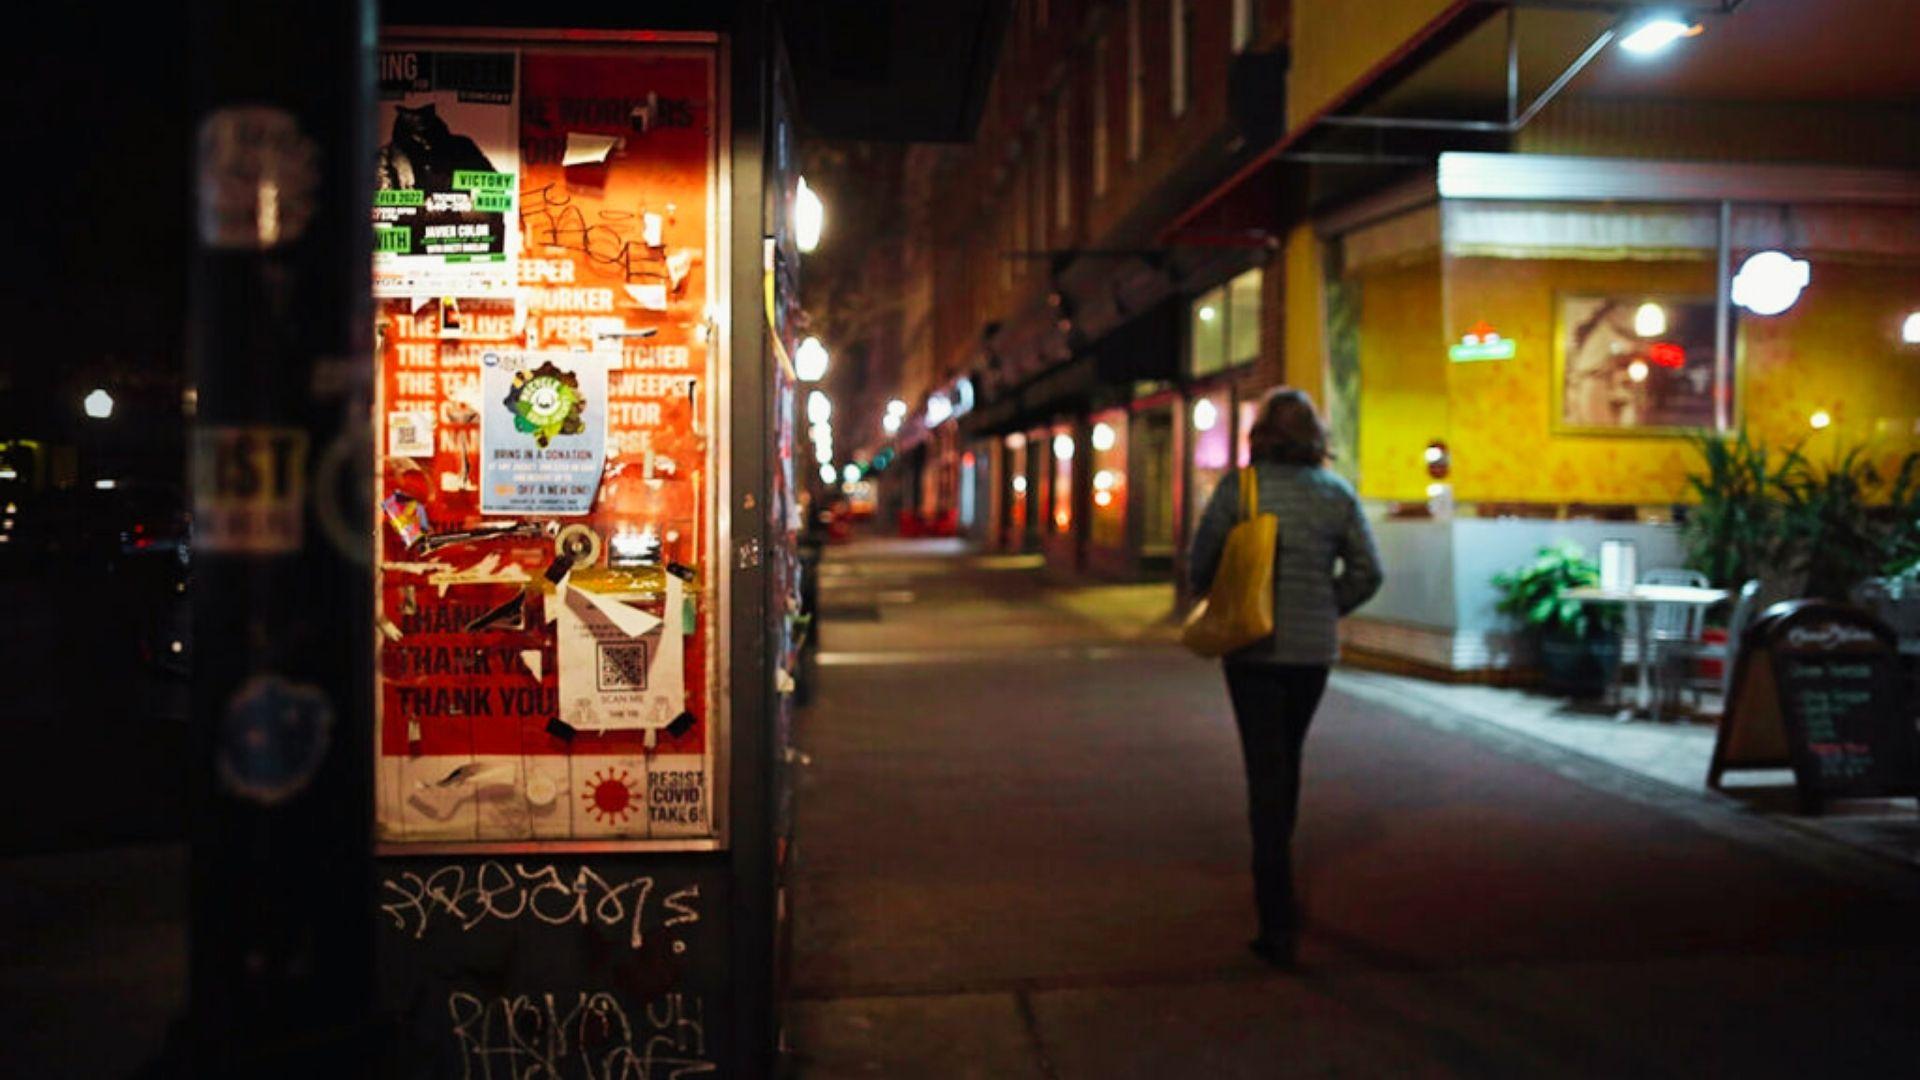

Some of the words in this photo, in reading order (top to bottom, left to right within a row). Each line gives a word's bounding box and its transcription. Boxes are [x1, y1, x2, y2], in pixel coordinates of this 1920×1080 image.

[381, 53, 418, 81] ING
[560, 97, 692, 129] WORKRS
[459, 174, 512, 187] VICTORY
[518, 259, 575, 282] EEPER
[395, 315, 436, 337] THE
[395, 344, 436, 366] THE
[622, 345, 689, 368] TCHER
[395, 372, 436, 395] THE
[608, 402, 661, 425] CTOR
[396, 646, 491, 675] THANK
[396, 687, 492, 716] THANK
[499, 687, 556, 716] YOU
[601, 694, 627, 704] SCAN
[629, 695, 644, 704] ME
[648, 771, 704, 785] RESIST
[654, 787, 700, 803] COVID
